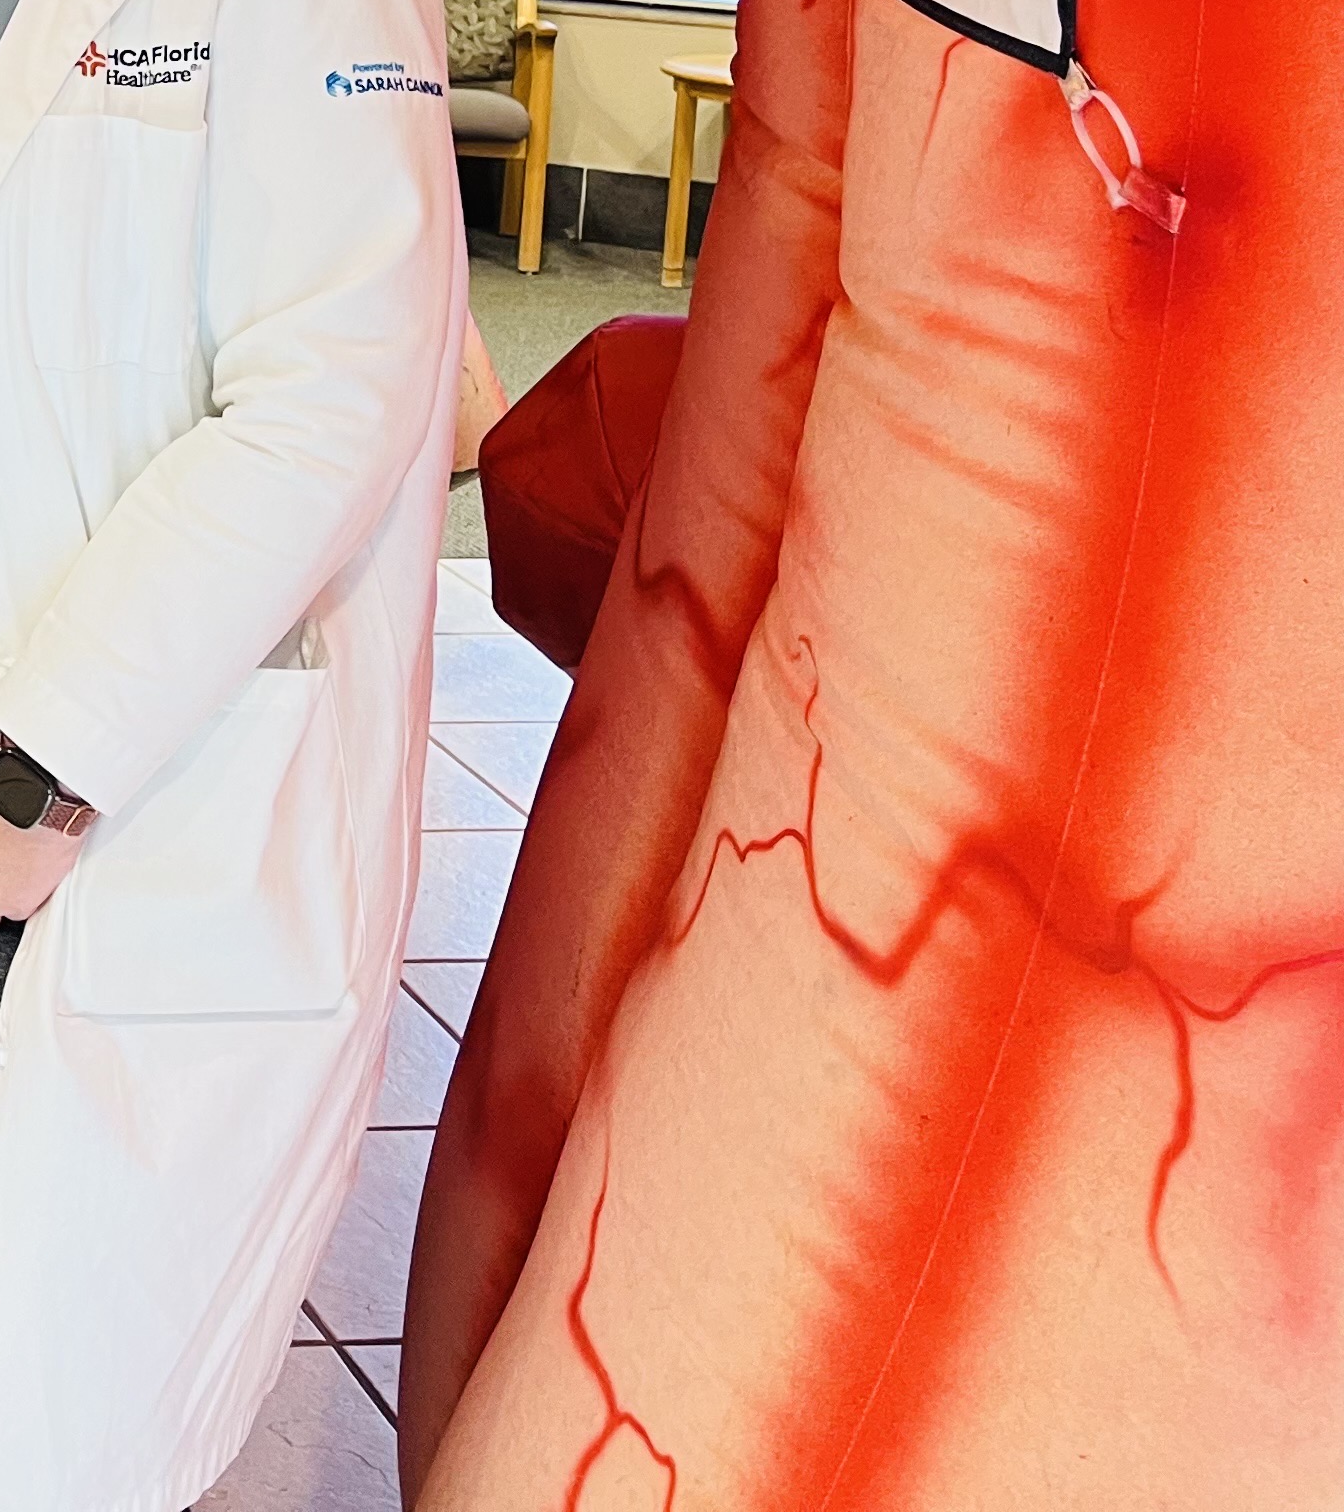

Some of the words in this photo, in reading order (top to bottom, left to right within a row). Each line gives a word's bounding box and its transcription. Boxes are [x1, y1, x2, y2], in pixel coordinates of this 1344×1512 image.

[152, 42, 210, 64] Florid
[352, 63, 393, 73] Powered
[394, 62, 404, 74] by
[107, 69, 192, 87] Healthcare
[355, 77, 404, 93] SARAH
